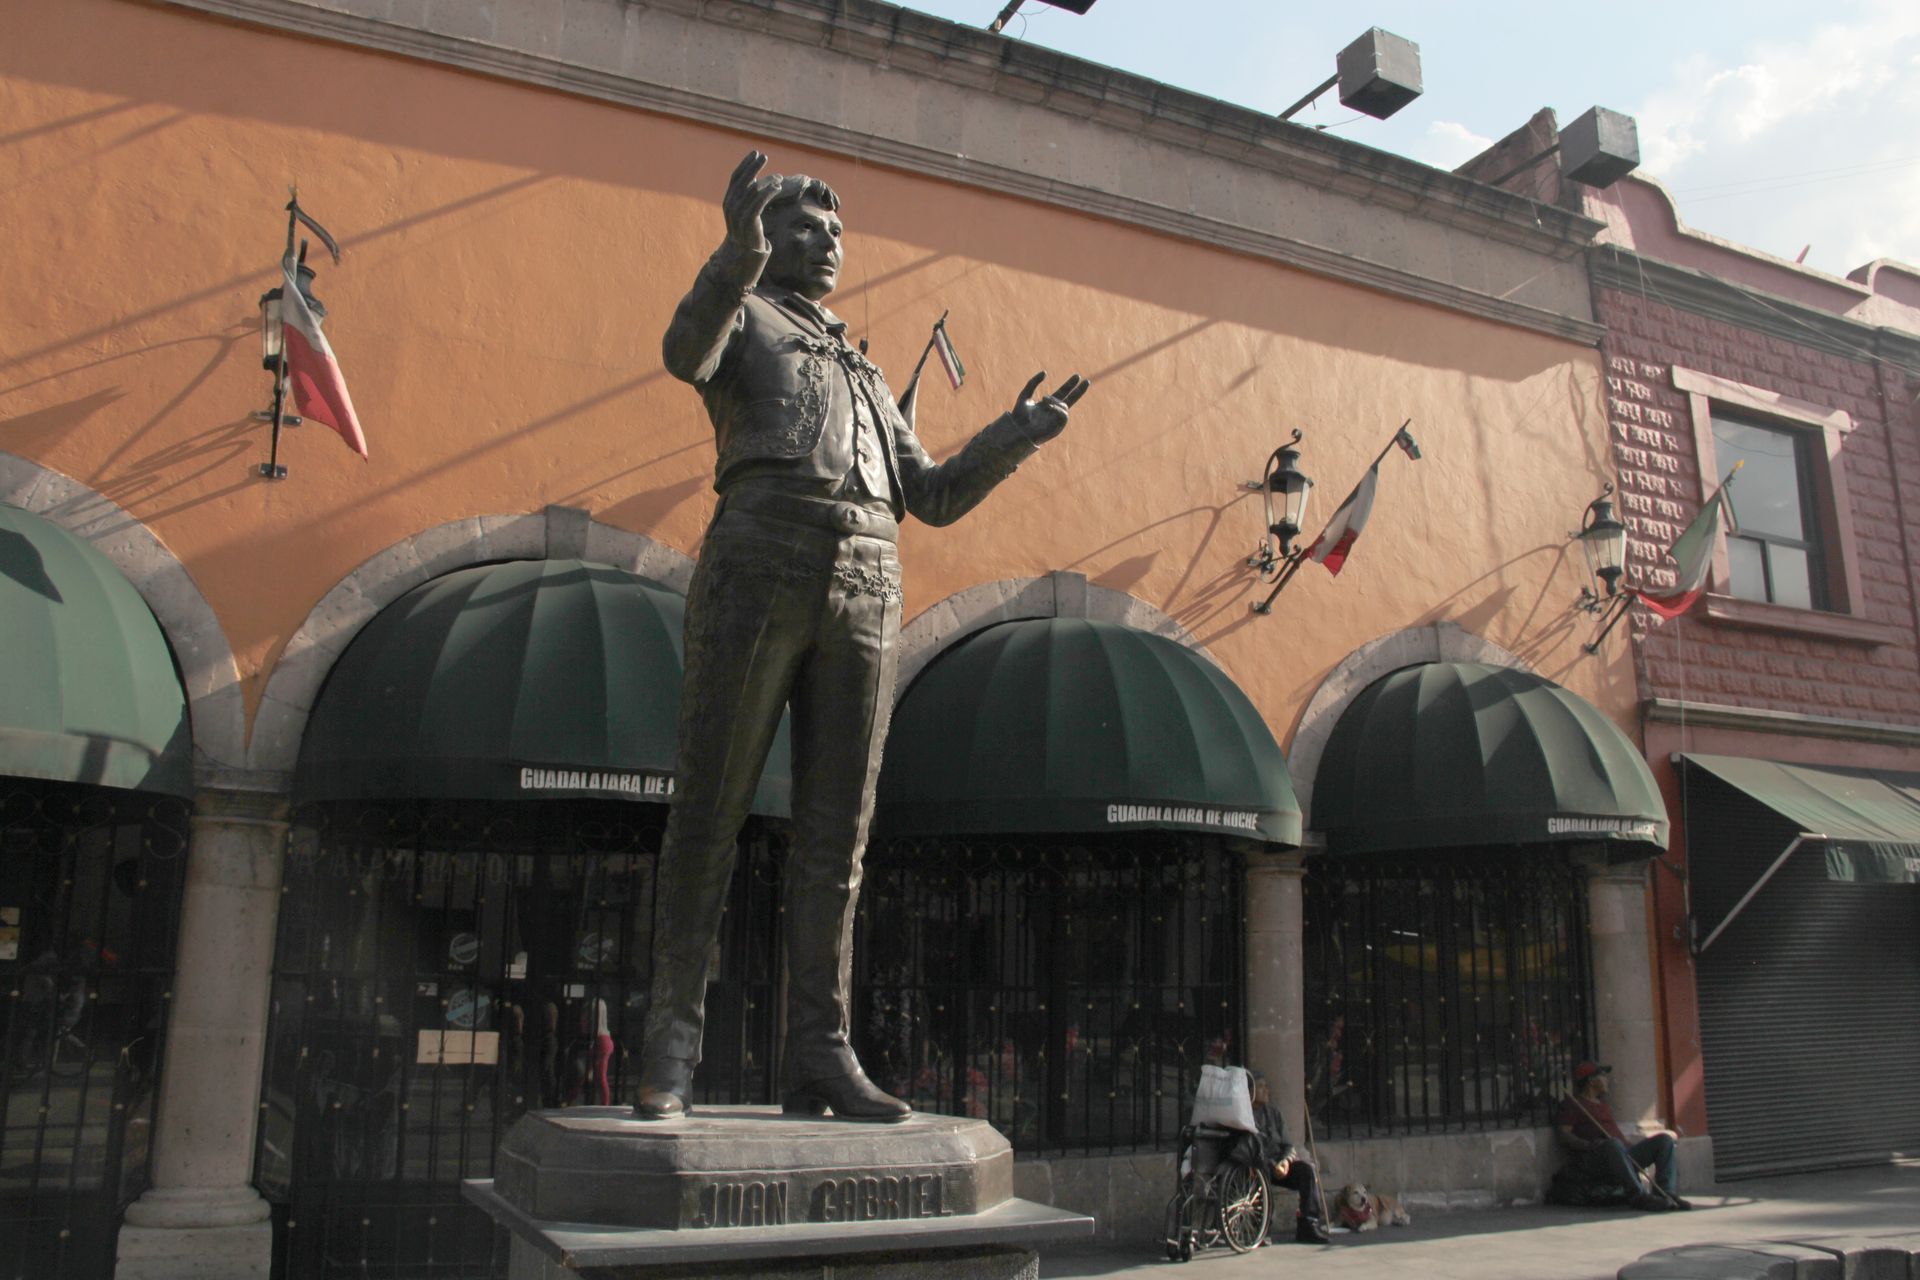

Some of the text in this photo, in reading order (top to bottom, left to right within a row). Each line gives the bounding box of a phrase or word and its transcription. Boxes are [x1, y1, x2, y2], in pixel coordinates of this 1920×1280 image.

[520, 767, 641, 794] GUADALAJARA
[643, 775, 665, 794] DE
[1107, 804, 1259, 831] GUADALAJARA DE NOCHE
[694, 1173, 954, 1229] JUAN GABRIEL
